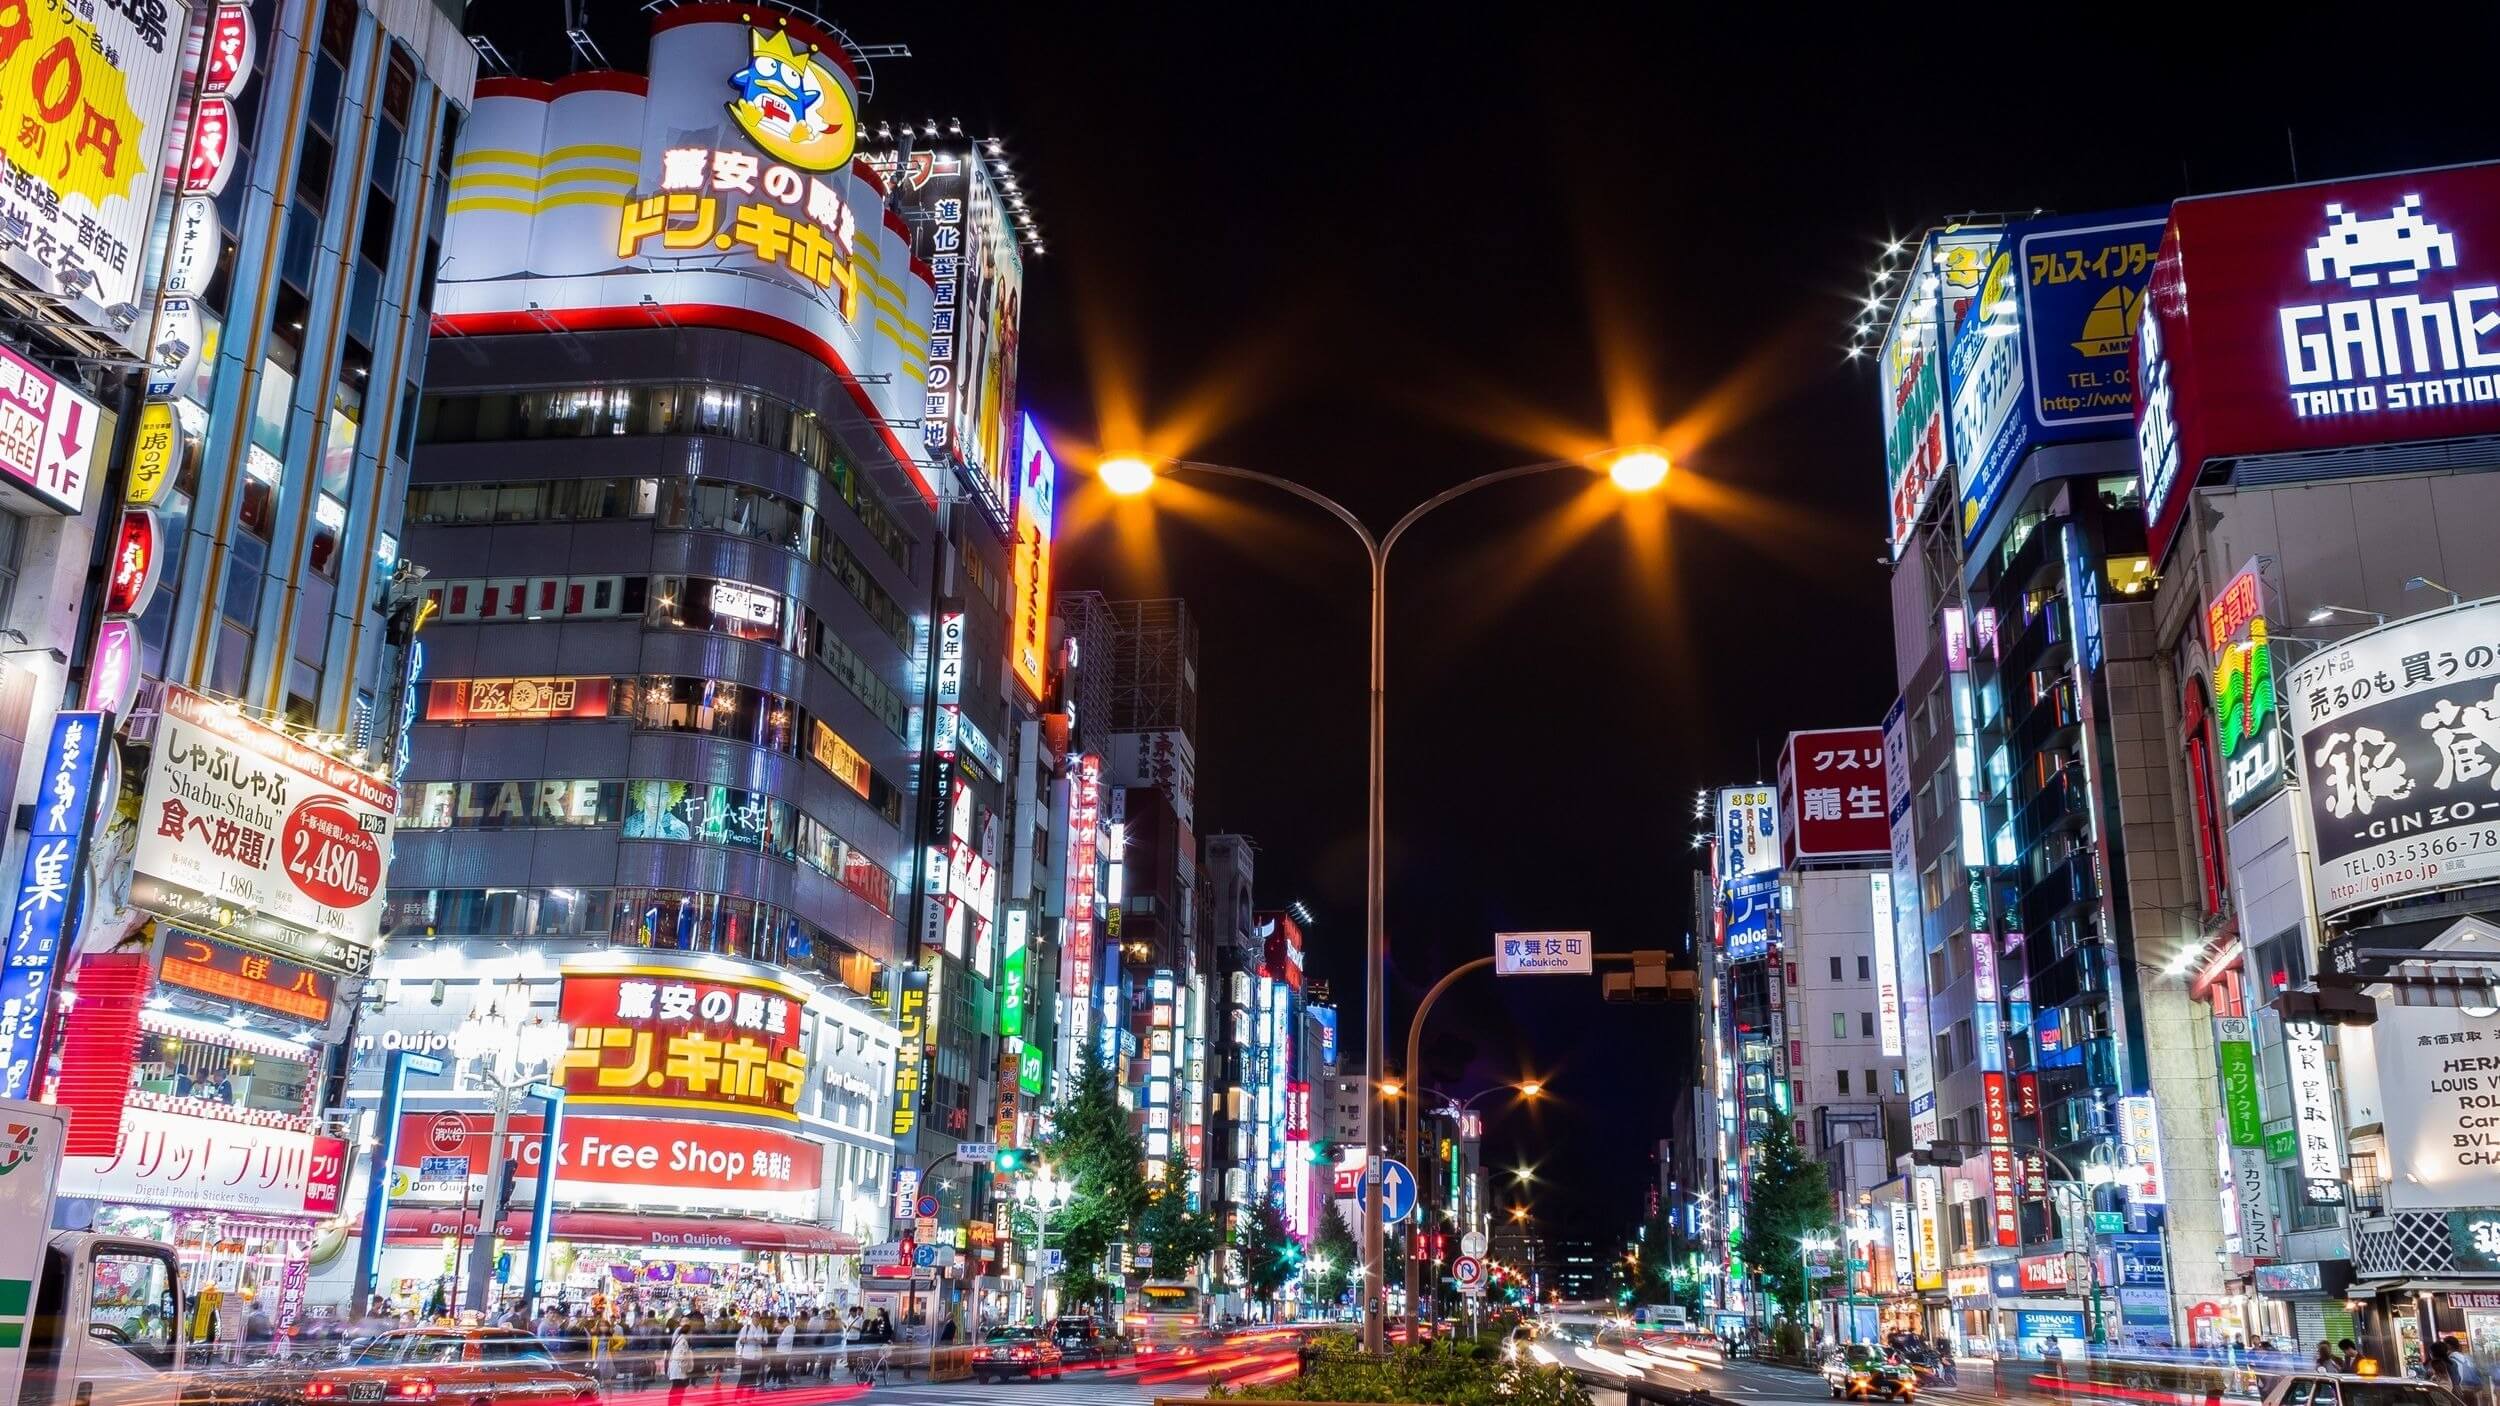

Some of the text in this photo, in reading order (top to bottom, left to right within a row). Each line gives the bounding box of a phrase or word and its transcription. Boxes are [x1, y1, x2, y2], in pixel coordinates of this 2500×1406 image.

[208, 82, 227, 92] 8F
[190, 180, 209, 189] 7F
[2030, 243, 2159, 287] アムス・インター
[923, 198, 962, 449] 進化型居酒屋の聖地
[2279, 285, 2500, 386] GAME
[0, 356, 49, 415] 買取
[153, 383, 168, 394] 5F
[2290, 386, 2378, 417] TAITO
[4, 406, 39, 446] TAX
[0, 431, 36, 470] FREE
[136, 433, 169, 482] 虎の子
[48, 462, 79, 496] 1F
[130, 488, 148, 500] 4F
[1026, 520, 1042, 648] PROMISE
[941, 622, 960, 697] 6年4組
[2293, 650, 2355, 694] ブランド品
[2308, 643, 2500, 722] 売るのも買うの
[168, 727, 291, 806] しゃぶしゃぶ
[1812, 748, 1883, 771] クスリ
[327, 762, 348, 785] for
[348, 773, 359, 793] 2
[360, 780, 395, 809] hours
[420, 781, 600, 818] FLARE
[685, 796, 769, 833] FLARE
[1803, 785, 1885, 821] 龍生
[157, 797, 277, 872] 食べ放題!
[360, 814, 387, 834] 120分
[18, 838, 70, 911] 集
[288, 828, 370, 897] 2,480 yen
[2329, 863, 2439, 901] http://ginzo.jp
[345, 941, 372, 971] 5F
[1503, 938, 1584, 957] 歌舞伎町
[1518, 957, 1569, 968] Kabukicho
[18, 970, 43, 1040] ワインと
[1006, 971, 1020, 1009] レイク
[616, 981, 789, 1035] 驚安の殿堂
[382, 1029, 462, 1053] Quijot
[2417, 1030, 2483, 1048] 高価買取
[826, 1065, 842, 1085] Don
[1022, 1054, 1041, 1082] レイク
[2431, 1077, 2478, 1094] LOUIS
[1000, 1092, 1016, 1120] 麻雀
[435, 1127, 463, 1143] 消火栓
[311, 1156, 337, 1179] プリ
[508, 1135, 746, 1182] Tax Free Shop
[750, 1150, 792, 1182] 免税店
[135, 1184, 260, 1206] Digital Photo Sticker Shop
[306, 1184, 337, 1201] 専門店
[411, 1180, 484, 1195] Don Quijote
[430, 1223, 458, 1236] Don
[651, 1230, 733, 1248] Don Quijote
[918, 1249, 927, 1263] P
[1051, 1251, 1060, 1264] P
[2450, 1292, 2500, 1309] TAX FREE
[2025, 1313, 2076, 1325] SUBNADE
